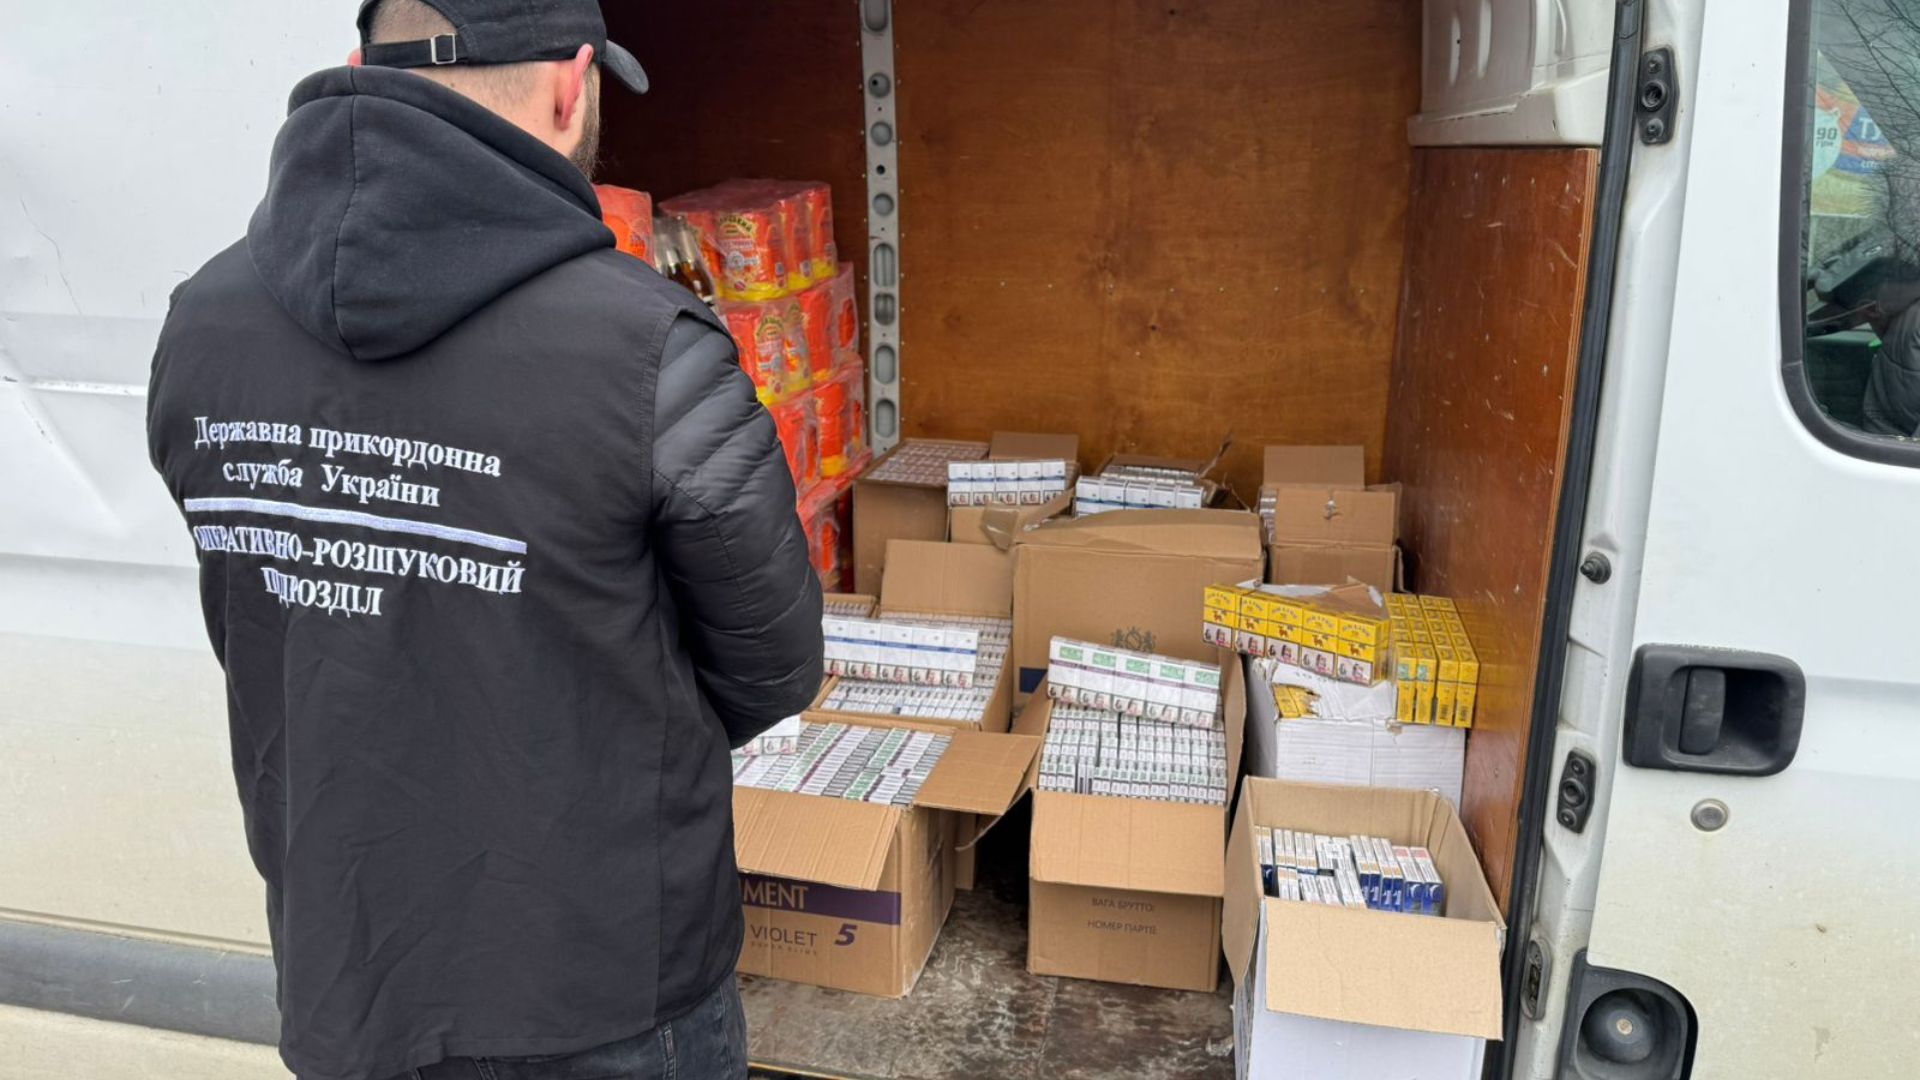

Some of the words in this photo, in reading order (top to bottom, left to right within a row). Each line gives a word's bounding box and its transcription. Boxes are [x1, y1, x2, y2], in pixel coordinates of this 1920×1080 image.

[1816, 127, 1838, 140] 90
[193, 416, 302, 451] Державна
[308, 427, 502, 477] прикордонна
[222, 458, 304, 491] служба
[320, 463, 441, 508] України
[260, 567, 384, 619] ПІДРОЗДІЛ
[1091, 897, 1115, 908] ВАГА
[750, 923, 818, 947] VIOLET
[834, 923, 858, 946] 5
[1087, 920, 1123, 932] НОМЕР
